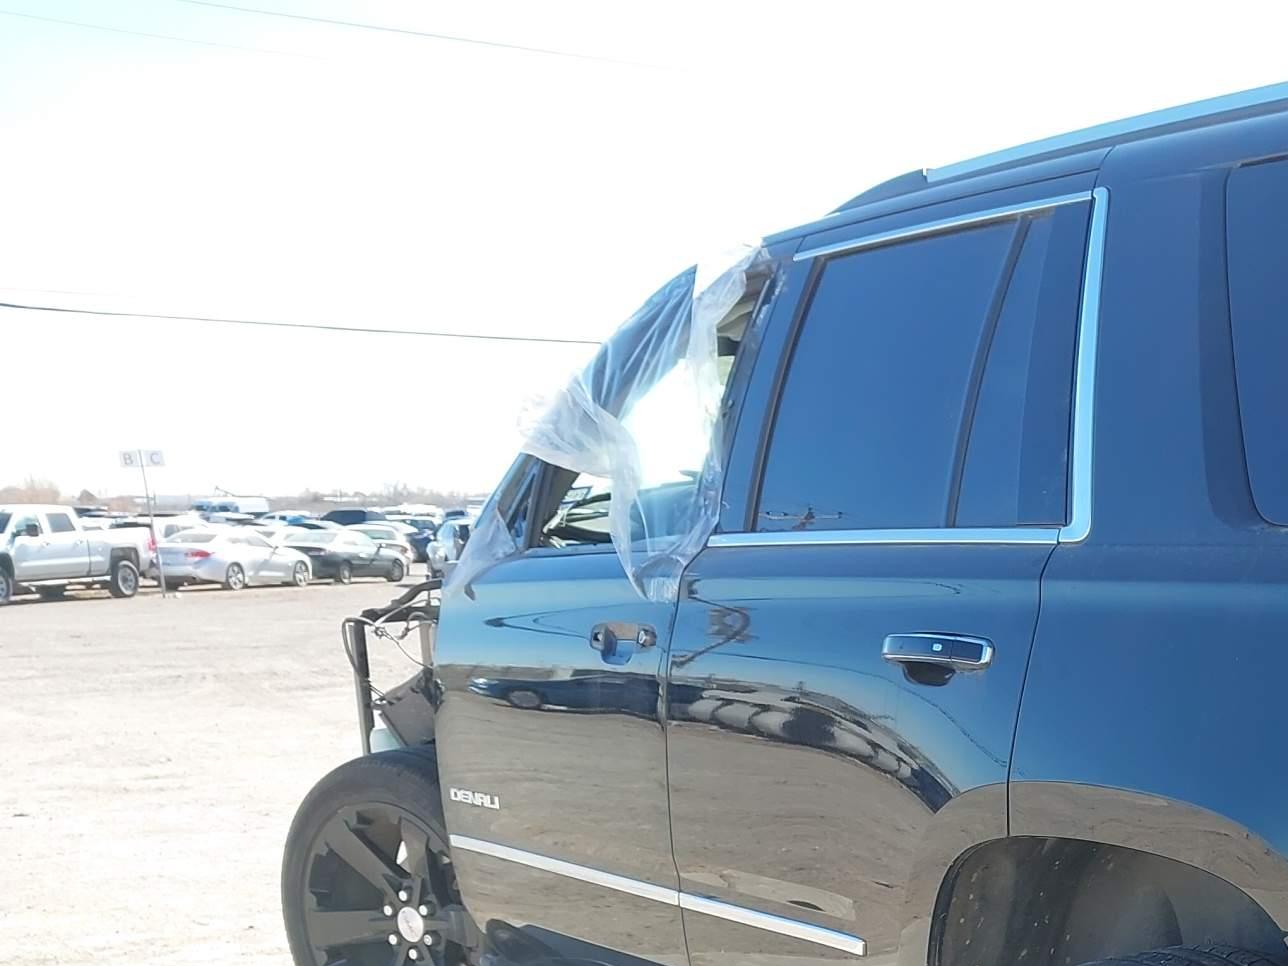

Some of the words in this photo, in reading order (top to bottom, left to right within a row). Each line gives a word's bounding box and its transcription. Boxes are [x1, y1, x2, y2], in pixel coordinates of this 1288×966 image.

[122, 452, 134, 466] B
[150, 451, 161, 465] C
[449, 787, 500, 810] DENALI
